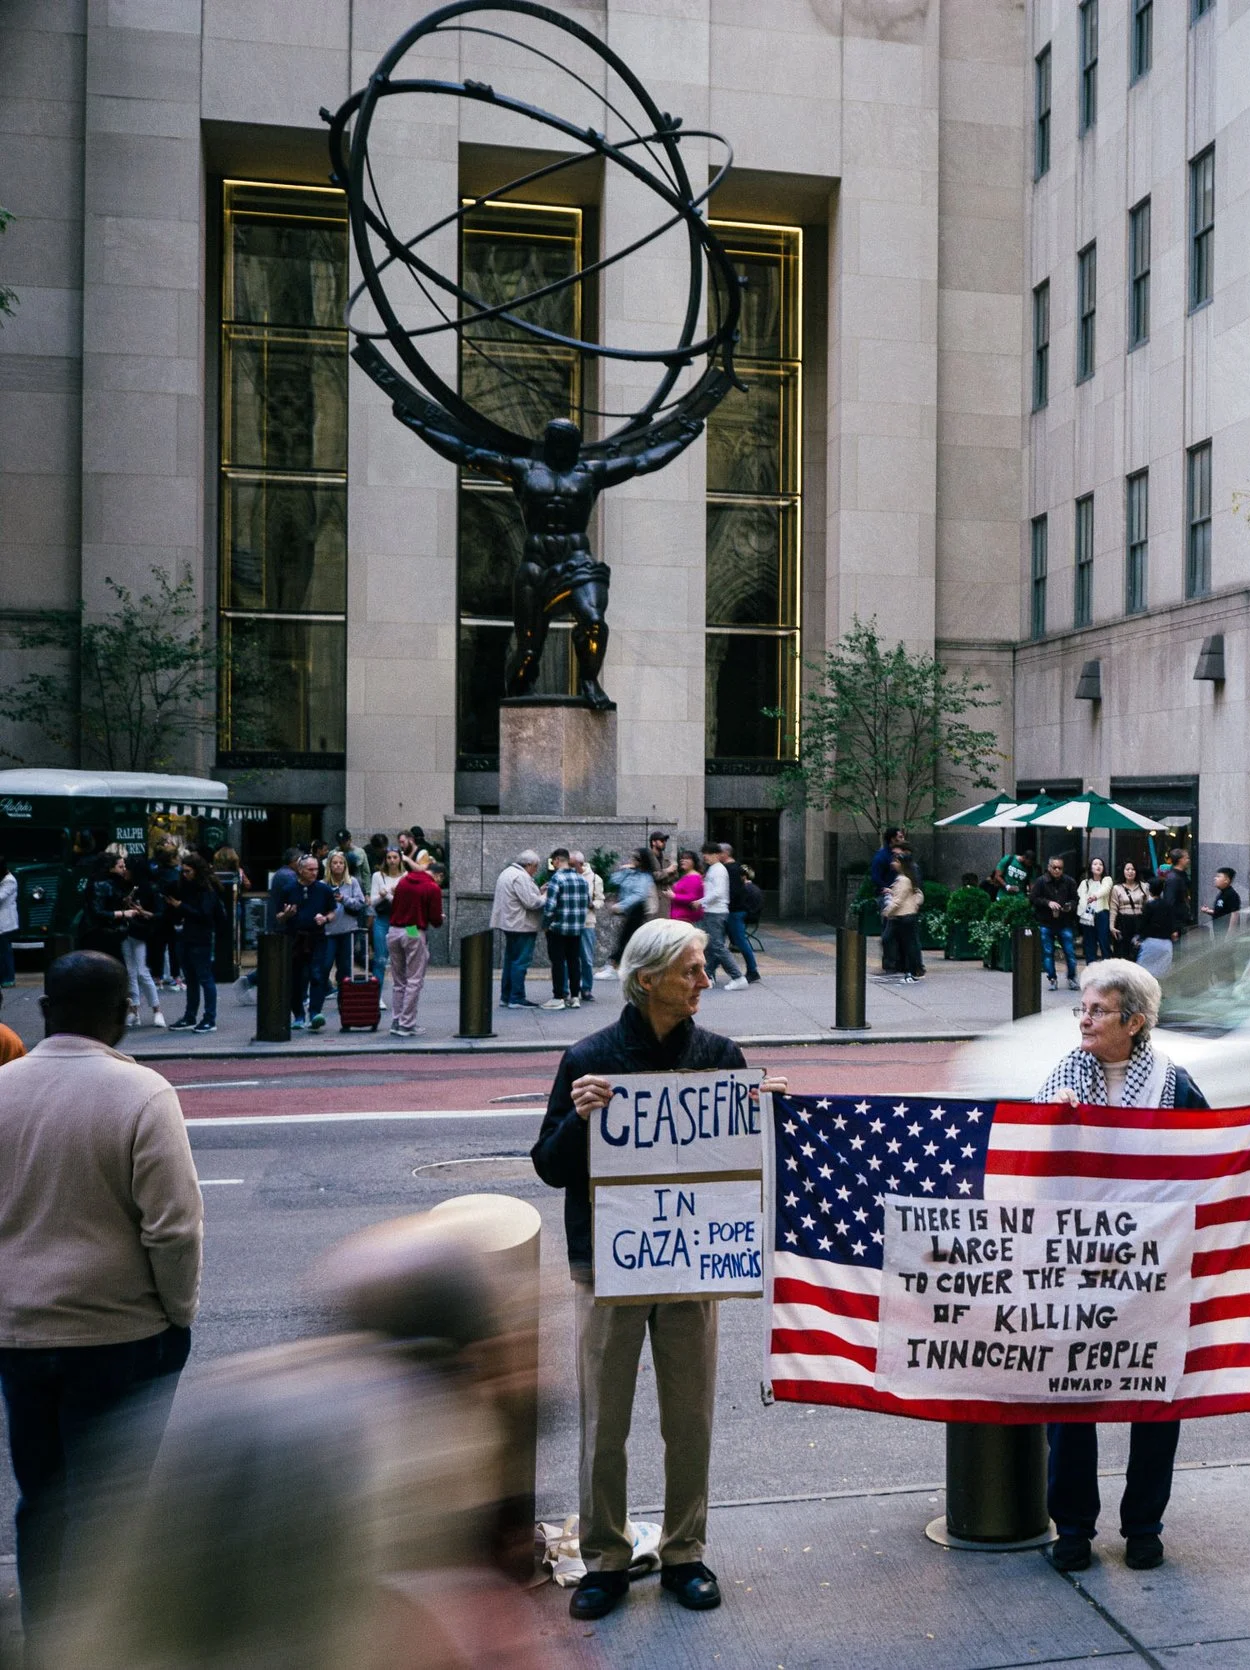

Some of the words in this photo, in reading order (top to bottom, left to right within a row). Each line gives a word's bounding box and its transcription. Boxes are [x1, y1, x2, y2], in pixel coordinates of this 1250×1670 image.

[116, 827, 144, 840] RALPH
[600, 1074, 761, 1149] CEASEFIRE
[653, 1189, 695, 1221] IN
[895, 1205, 960, 1232] THERE
[969, 1208, 989, 1232] IS
[999, 1206, 1035, 1234] NO
[1056, 1208, 1138, 1237] FLAG
[613, 1228, 700, 1269] GAZA:
[708, 1221, 755, 1244] POPE
[931, 1235, 1013, 1265] LARGE
[1046, 1238, 1160, 1266] ENOUGH
[701, 1248, 761, 1280] FRANCIS
[899, 1272, 928, 1294] TO
[936, 1268, 1014, 1297] COVER
[1023, 1267, 1067, 1290] THE
[1077, 1269, 1168, 1293] SHAME
[933, 1304, 971, 1324] OF
[994, 1303, 1118, 1334] KILLING
[907, 1338, 1054, 1372] INNOCENT
[1067, 1340, 1159, 1373] PEOPLE
[1048, 1376, 1113, 1392] HOWARD
[1119, 1376, 1167, 1392] ZINN
